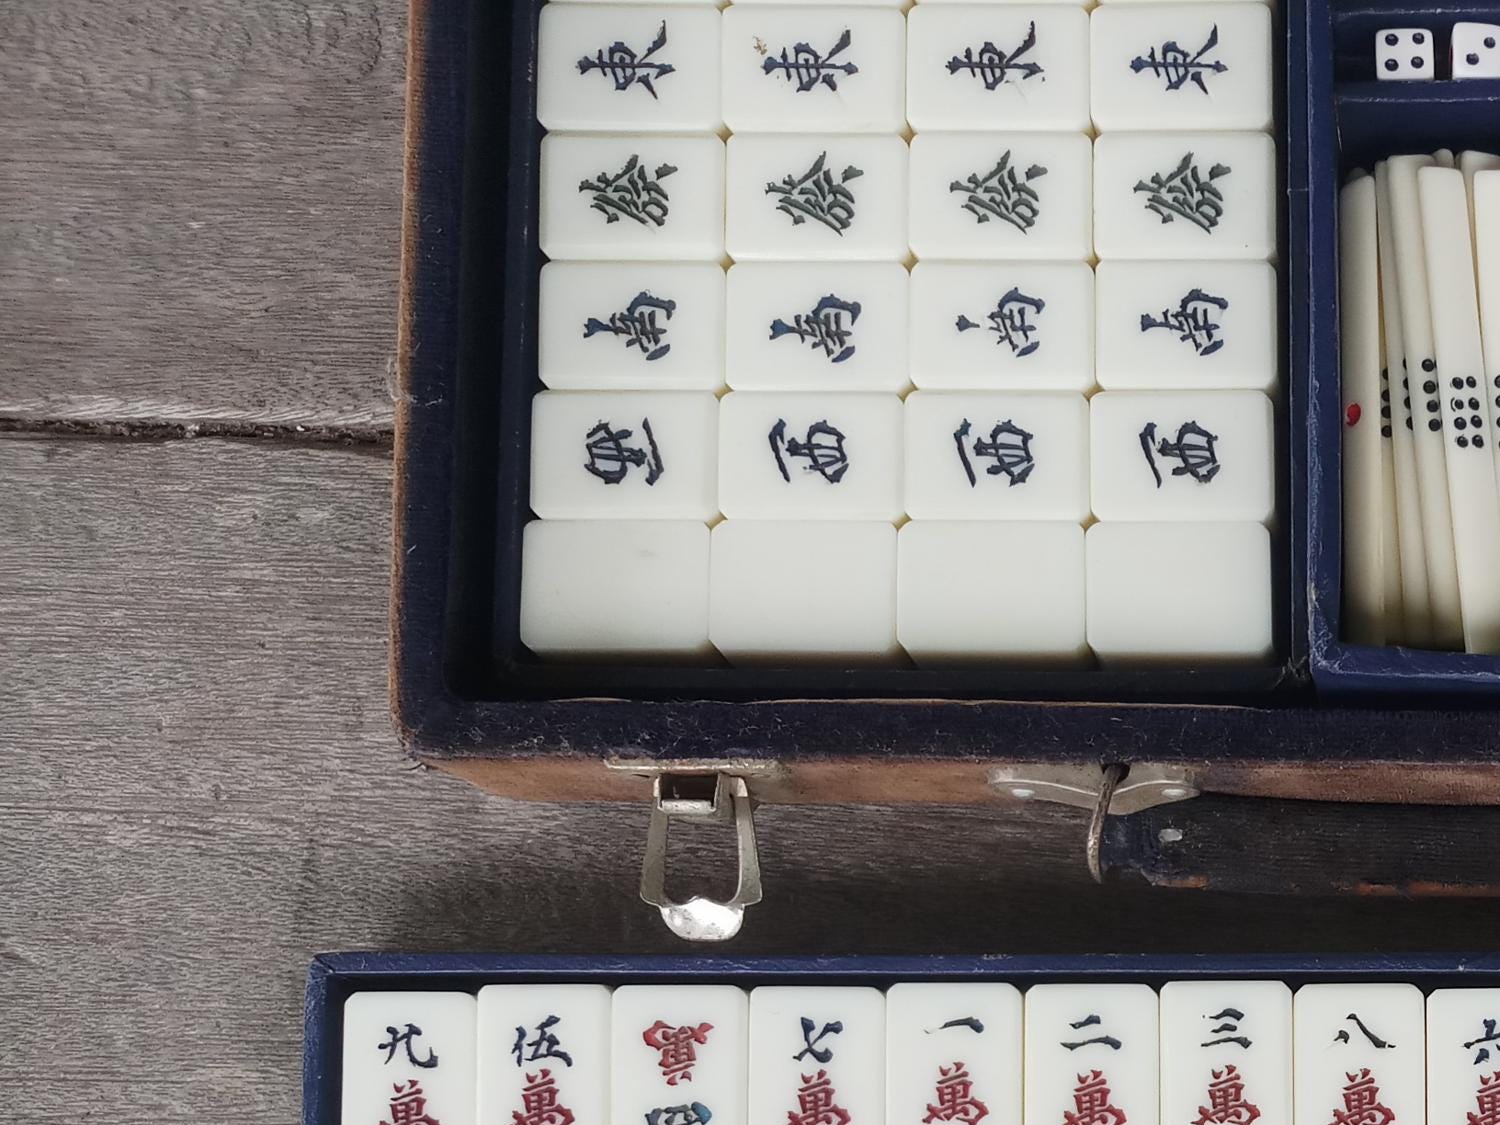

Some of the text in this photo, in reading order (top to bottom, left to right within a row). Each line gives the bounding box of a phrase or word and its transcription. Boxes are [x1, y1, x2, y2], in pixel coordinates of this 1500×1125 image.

[576, 20, 675, 99] 東
[762, 30, 858, 92] 東
[945, 21, 1044, 90] 東
[1130, 25, 1228, 94] 東
[583, 292, 676, 360] 南
[770, 294, 861, 362] 南
[956, 287, 1045, 357] 南
[1141, 289, 1228, 356] 南
